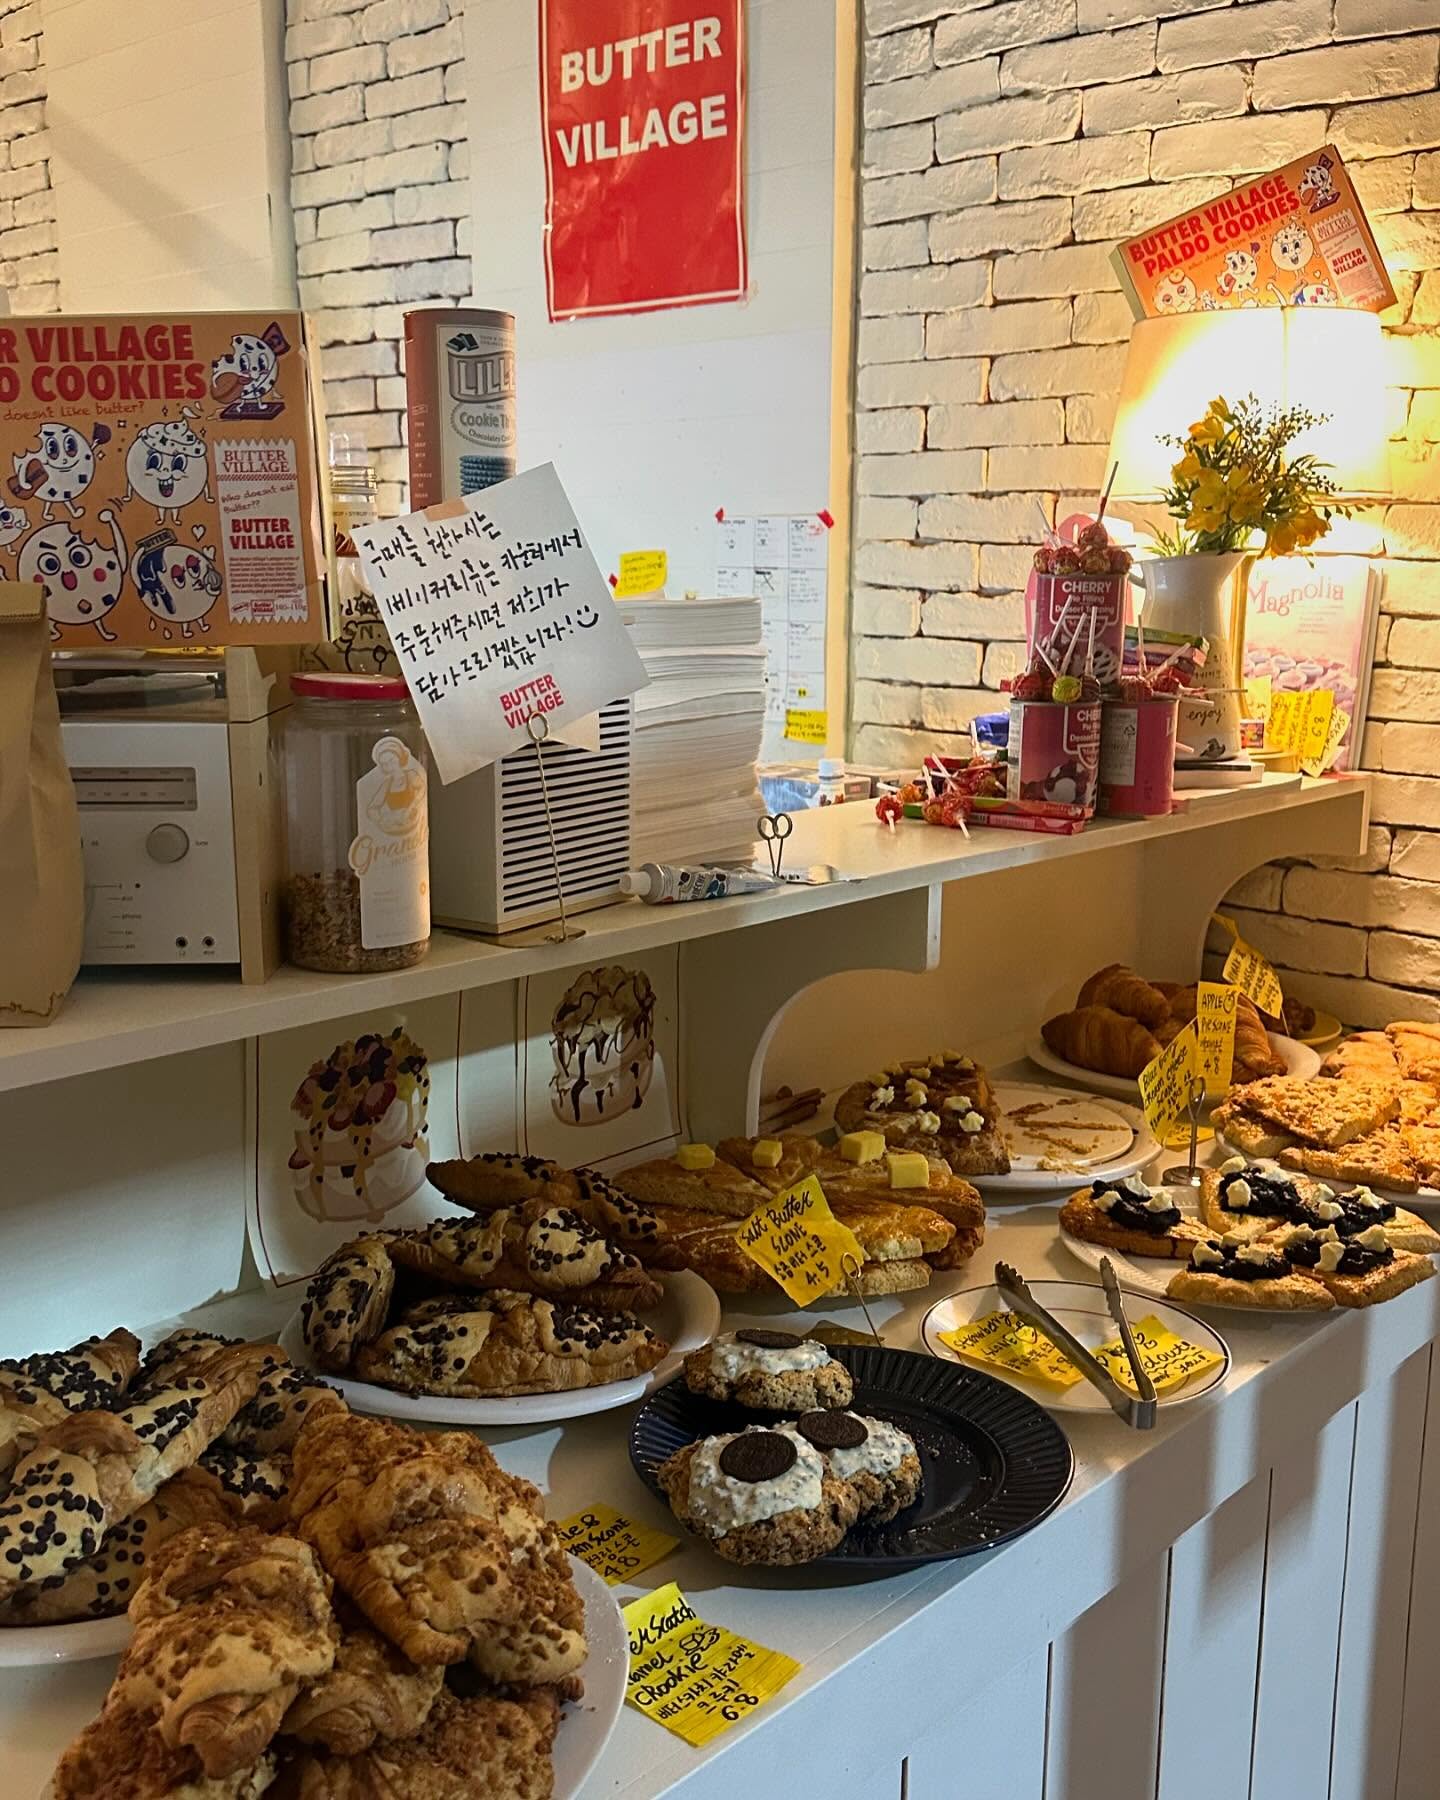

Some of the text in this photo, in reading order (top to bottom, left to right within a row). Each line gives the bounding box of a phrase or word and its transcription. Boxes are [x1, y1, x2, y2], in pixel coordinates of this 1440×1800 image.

[560, 16, 722, 94] BUTTER
[556, 94, 728, 168] VILLAGE
[1127, 174, 1288, 264] BUTTER VILLAGE
[1142, 232, 1211, 279] PALDO
[1212, 191, 1300, 245] COOKIES
[1331, 247, 1363, 267] BUTTER
[1332, 255, 1369, 276] VILLAGE
[25, 324, 195, 362] VILLAGE
[31, 363, 208, 401] COOKIES
[3, 405, 55, 421] doesn't
[95, 400, 146, 416] butter?
[459, 410, 499, 427] Cookie
[223, 459, 290, 474] VILLAGE
[224, 449, 288, 464] BUTTER
[230, 534, 295, 550] VILLAGE
[231, 518, 290, 534] BUTTER
[363, 511, 502, 578] 구매를 원하시는
[386, 528, 583, 615] 베이커리류는 카운터에서
[1061, 581, 1112, 594] CHERRY
[1248, 575, 1344, 617] Magnolia
[395, 602, 506, 662] 주문해주시면
[507, 577, 570, 616] 저희가
[499, 674, 556, 711] BUTTER
[503, 690, 565, 730] VILLAGE
[1202, 993, 1223, 1009] APPLE
[771, 1222, 808, 1256] SCONE
[805, 1260, 830, 1286] 4.5
[954, 1313, 1015, 1350] Strawberry
[604, 1557, 641, 1577] 4.8
[721, 1692, 759, 1721] 6.8
